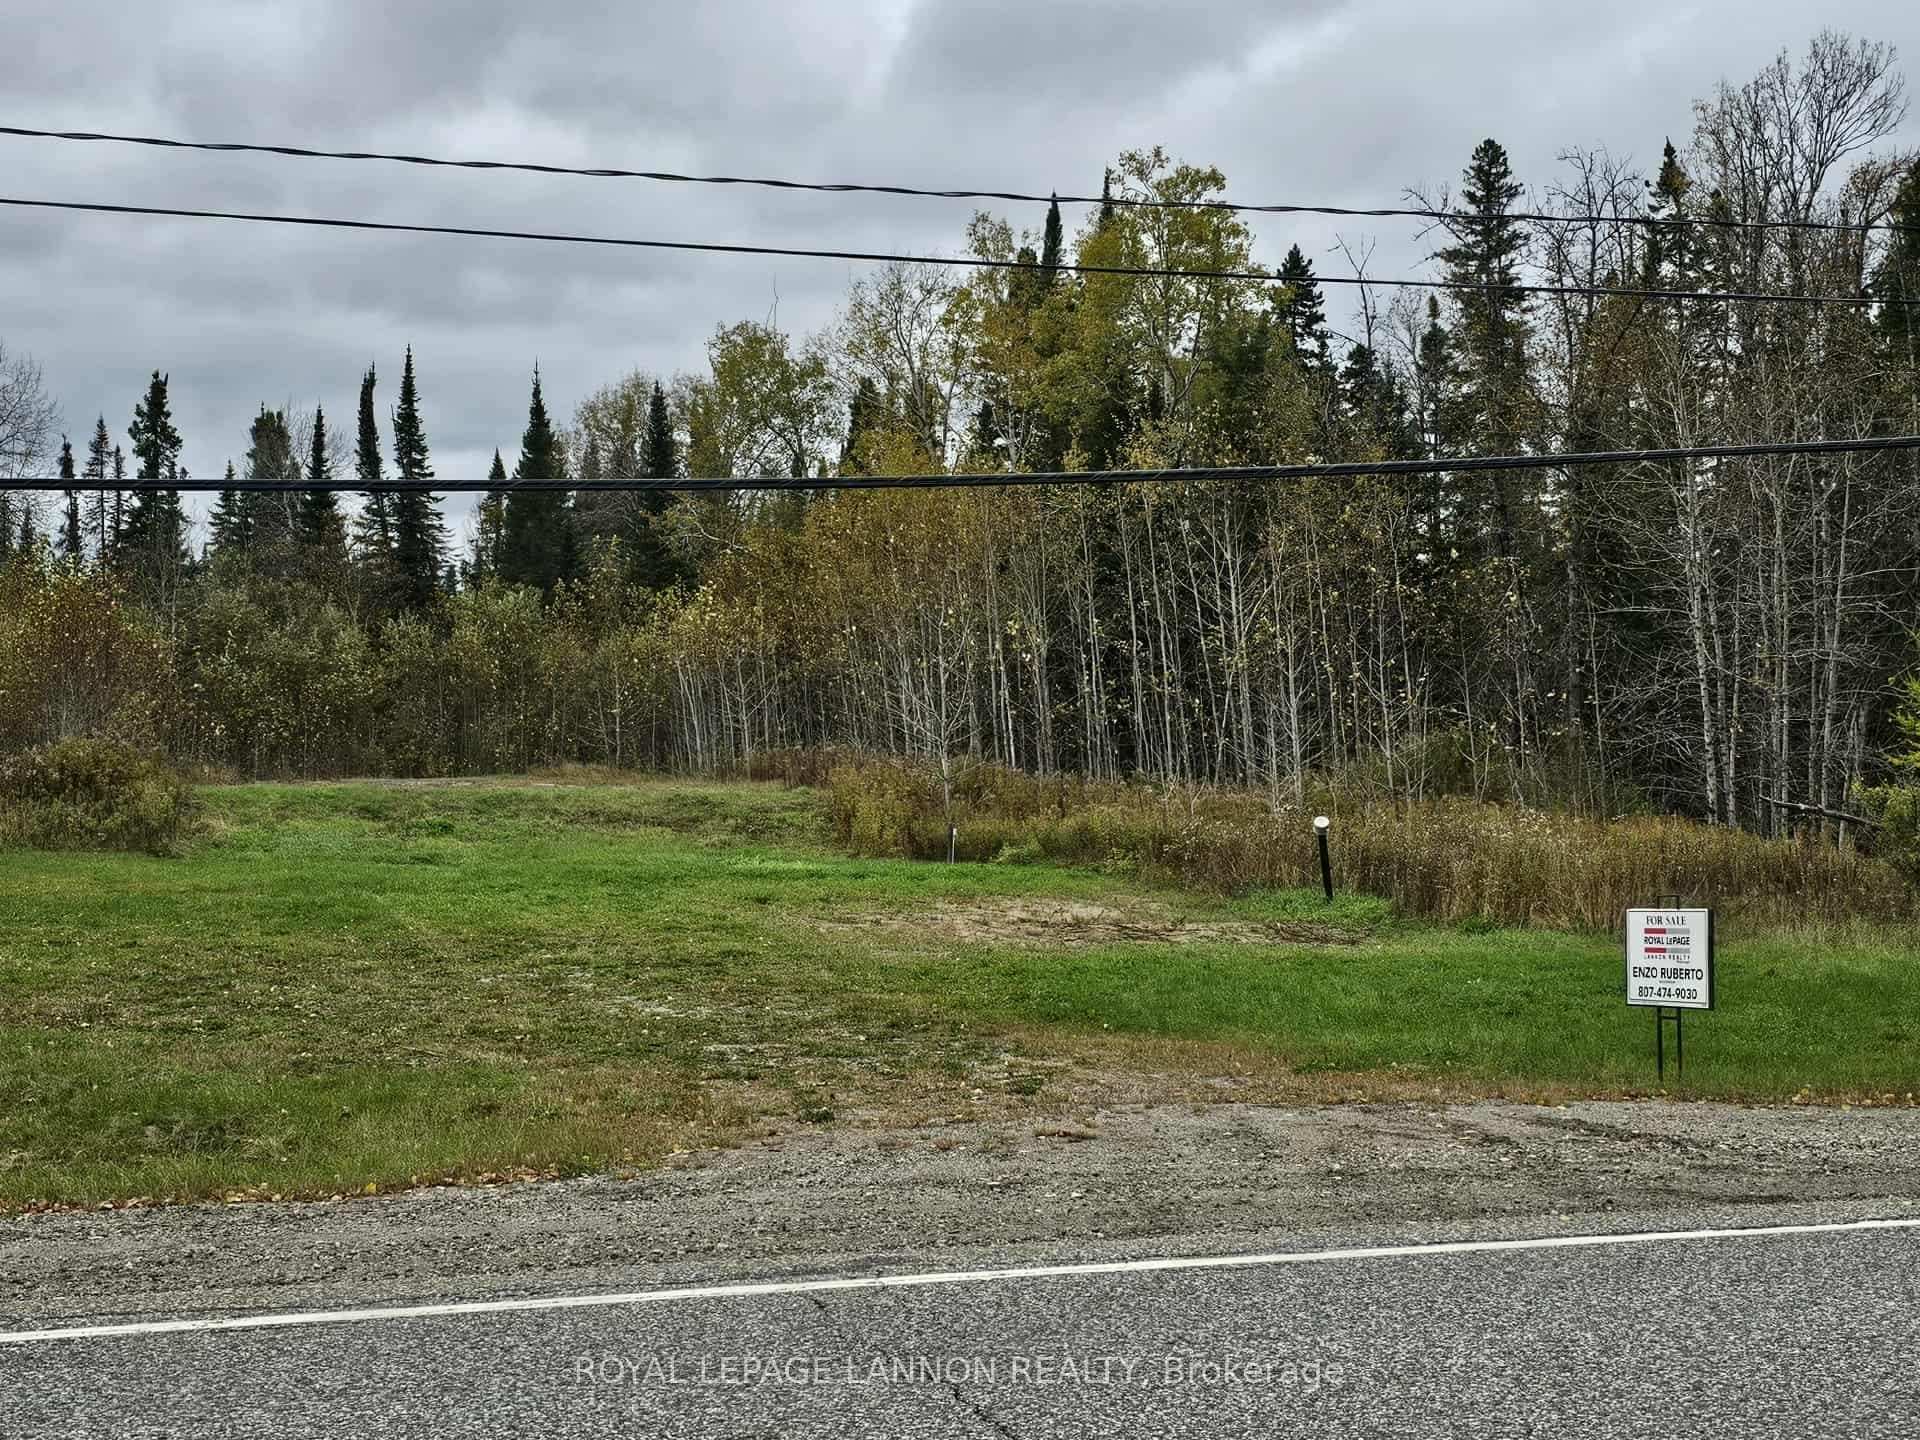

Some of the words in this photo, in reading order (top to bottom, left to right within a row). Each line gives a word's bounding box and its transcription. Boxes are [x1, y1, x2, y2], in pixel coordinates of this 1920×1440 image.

[1646, 915, 1663, 926] FOR
[1665, 915, 1686, 926] SALE
[1644, 936, 1664, 945] ROYAL
[1632, 966, 1658, 978] ENZO
[1660, 967, 1704, 980] RUBERTO
[1638, 986, 1698, 1000] 807-474-9030
